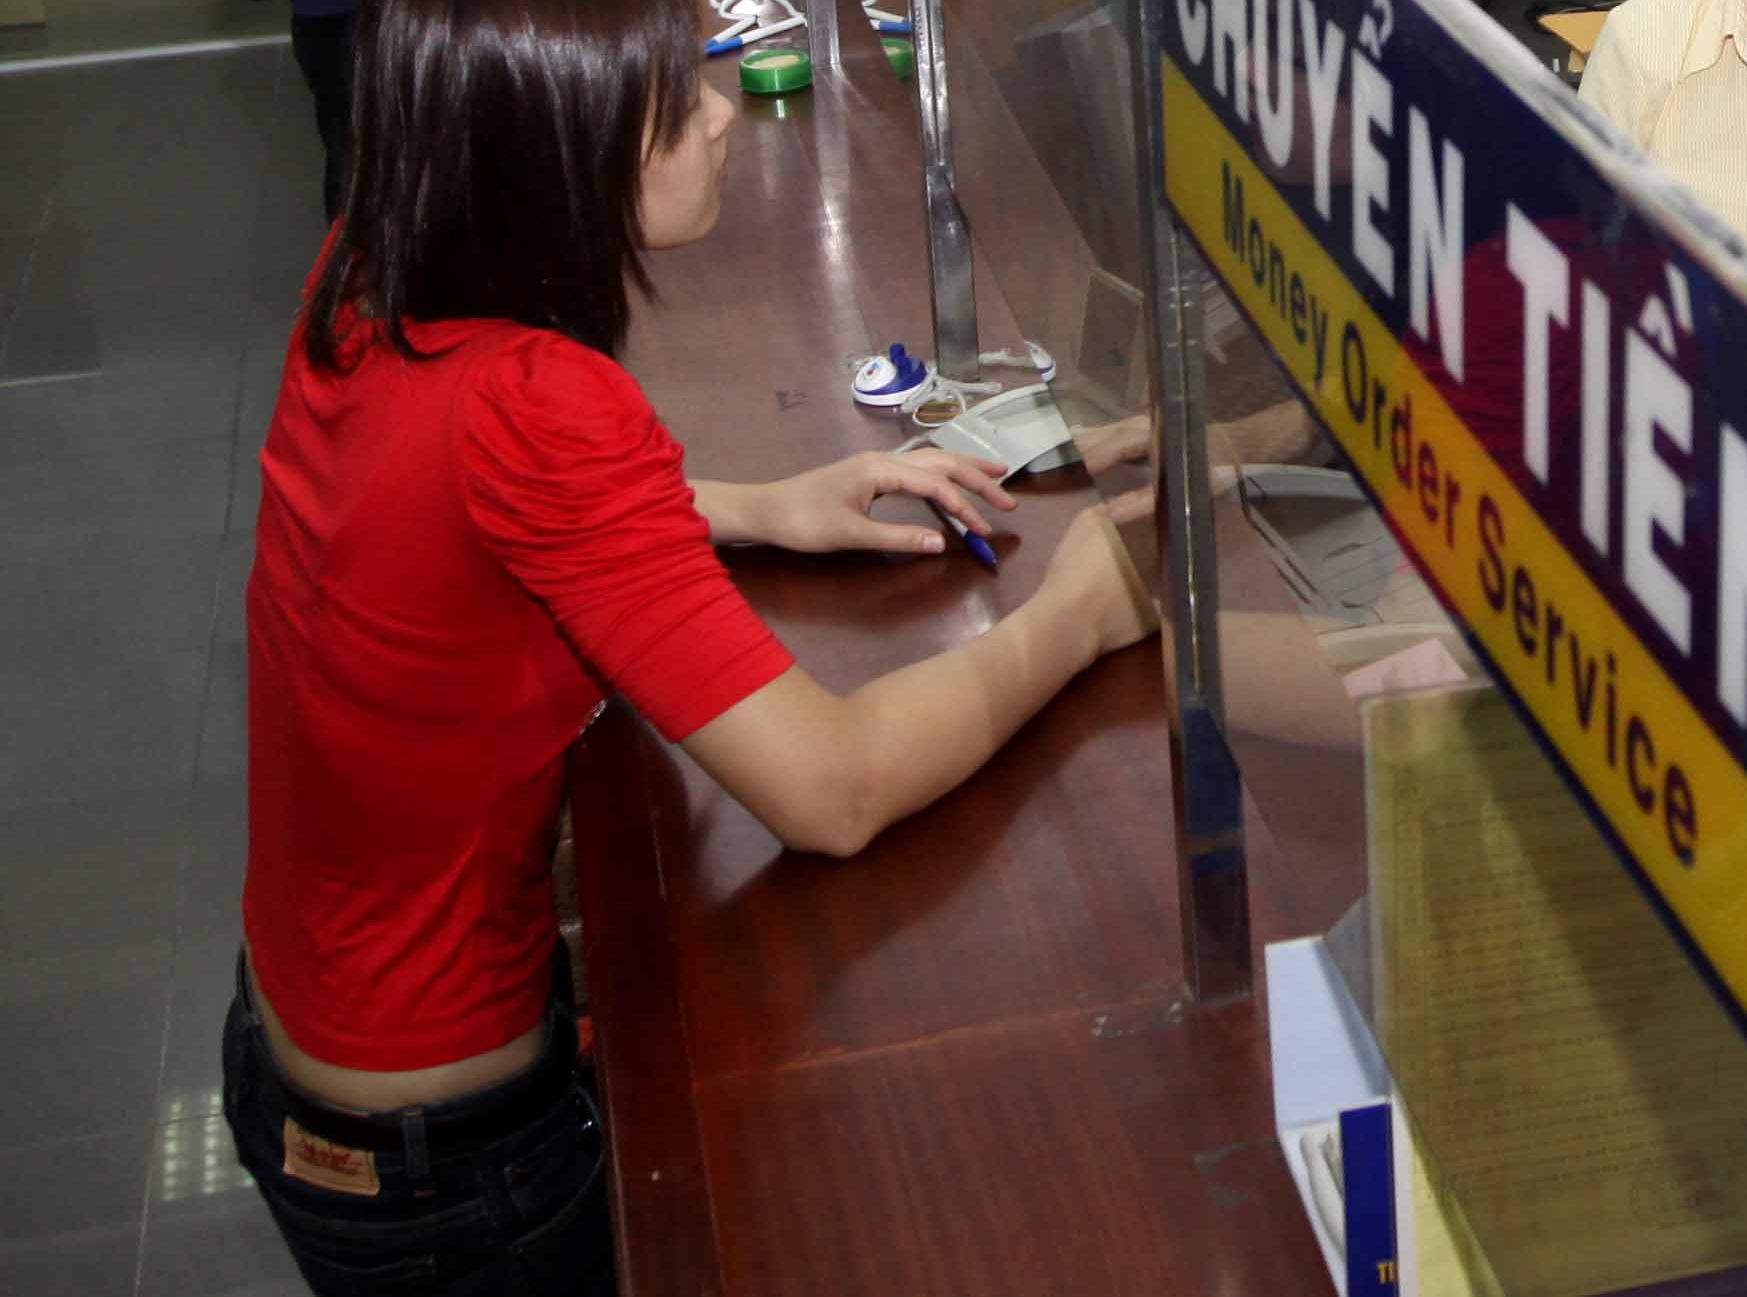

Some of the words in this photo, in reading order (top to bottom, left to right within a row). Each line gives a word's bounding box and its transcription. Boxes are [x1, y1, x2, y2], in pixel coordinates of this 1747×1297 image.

[1221, 158, 1328, 386] Money
[1341, 320, 1461, 550] Order
[1477, 494, 1698, 870] Service
